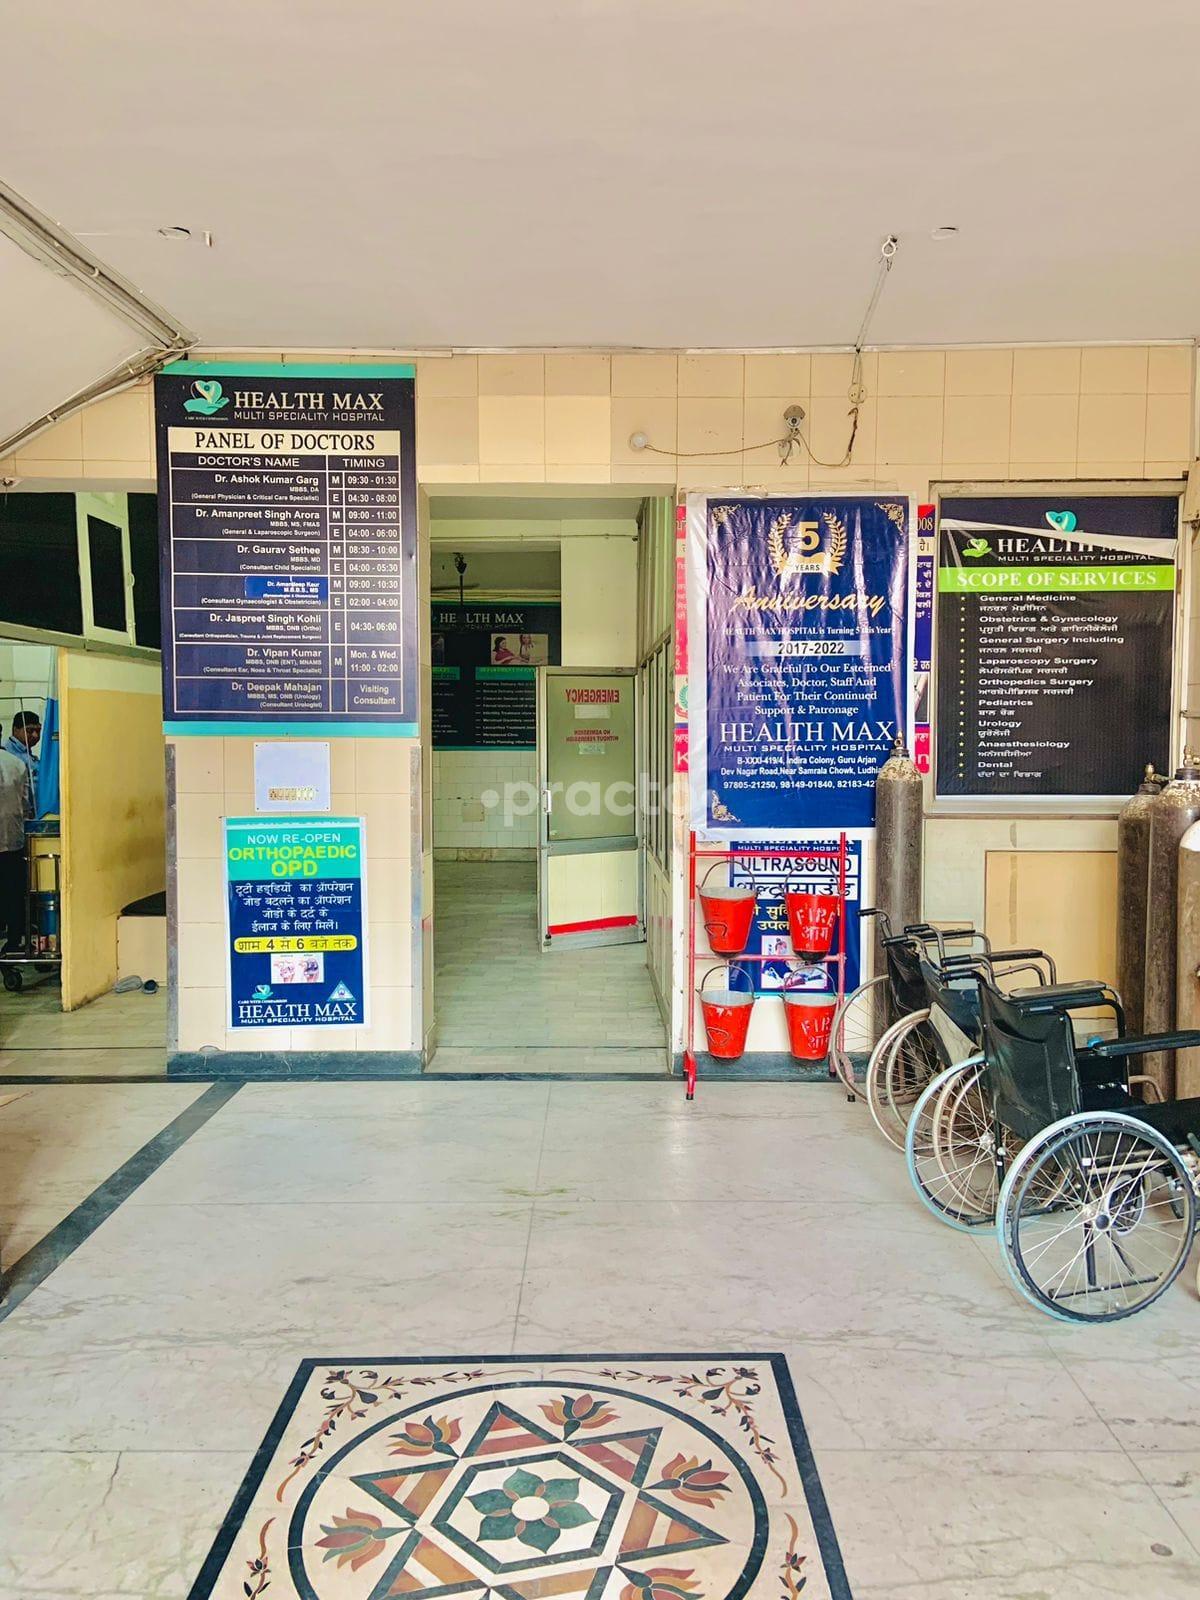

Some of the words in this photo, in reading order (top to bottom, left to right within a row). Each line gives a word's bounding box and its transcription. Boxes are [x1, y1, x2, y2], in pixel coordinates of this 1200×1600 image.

[234, 391, 323, 410] HEALTH
[333, 393, 384, 410] MAX
[269, 412, 328, 421] SPECIALITY
[333, 413, 384, 422] HOSPITAL
[195, 432, 254, 449] PANEL
[261, 434, 284, 449] OF
[291, 434, 375, 450] DOCTORS
[198, 456, 261, 466] DOCTOR'S
[265, 458, 300, 467] NAME
[342, 458, 385, 468] TIMING
[215, 475, 227, 483] Dr.
[230, 475, 260, 484] Ashok
[263, 475, 293, 484] Kumar
[296, 476, 318, 486] Garg
[332, 476, 340, 484] M
[196, 509, 208, 517] Dr.
[211, 510, 262, 520] Amanpreet
[264, 510, 291, 520] Singh
[294, 511, 320, 519] Arora
[799, 521, 820, 551] 5
[238, 546, 250, 554] Dr.
[253, 546, 285, 554] Gaurav
[289, 546, 320, 554] Sethee
[957, 572, 1021, 587] SCOPE
[1028, 572, 1054, 585] OF
[1060, 571, 1156, 585] SERVICES
[728, 585, 885, 617] Anniversary
[210, 614, 222, 622] Dr.
[225, 614, 265, 624] Jaspreet
[268, 614, 295, 624] Singh
[297, 614, 321, 623] Kohli
[440, 613, 490, 623] HELTH
[495, 613, 523, 623] MAX
[980, 615, 1036, 623] Obstetrics
[1052, 615, 1118, 624] Gynecology
[979, 636, 1022, 644] General
[1025, 636, 1069, 645] Surgery
[1073, 636, 1124, 644] Including
[778, 642, 844, 654] 2017-2022
[247, 649, 260, 657] Dr.
[263, 649, 290, 659] Vipan
[292, 649, 321, 657] Kumar
[351, 650, 368, 659] Mon.
[371, 651, 376, 659] &
[379, 651, 398, 659] Wed.
[979, 657, 1050, 666] Laparoscopy
[1054, 657, 1098, 665] Surgery
[724, 664, 740, 673] We
[742, 664, 758, 673] Are
[760, 664, 801, 674] Grateful
[804, 664, 817, 672] To
[820, 664, 840, 673] Our
[843, 664, 890, 673] Esteemed
[738, 678, 788, 688] Associates,
[792, 678, 827, 688] Doctor,
[831, 677, 853, 686] Staff
[855, 678, 876, 686] And
[1050, 678, 1093, 686] Surgery
[232, 683, 244, 691] Dr.
[247, 683, 281, 692] Deepak
[284, 683, 322, 693] Mahajan
[360, 684, 389, 695] Visiting
[354, 696, 396, 704] Consultant
[737, 692, 770, 701] Patient
[794, 692, 821, 700] Their
[825, 691, 877, 700] Continued
[755, 706, 795, 717] Support
[797, 706, 805, 714] &
[809, 706, 859, 717] Patronage
[978, 720, 1021, 728] Urology
[721, 723, 826, 742] HEALTH
[832, 721, 894, 741] MAX
[831, 743, 889, 751] HOSPITAL
[978, 741, 1070, 749] Anaesthesiology
[809, 756, 835, 766] Colony,
[838, 756, 855, 764] Guru
[857, 756, 876, 765] Arjan
[736, 768, 758, 777] Nagar
[798, 767, 827, 775] Samrala
[829, 767, 855, 775] Chowk,
[724, 782, 778, 790] 97805-21250,
[780, 781, 835, 789] 98149-01840,
[248, 834, 278, 844] NOW
[283, 833, 340, 843] RE-OPEN
[228, 845, 356, 860] ORTHOPAEDIC
[271, 860, 318, 877] OPD
[741, 857, 852, 871] ULTRASOUND
[300, 883, 313, 892] का
[298, 895, 310, 904] का
[797, 908, 835, 927] FIRE
[281, 921, 290, 930] के
[294, 920, 312, 931] लिए
[238, 940, 260, 951] शाम
[266, 940, 275, 950] 4
[296, 938, 305, 950] 6
[334, 938, 352, 948] तक
[238, 1004, 310, 1018] HEALTH
[316, 1003, 357, 1016] MAX
